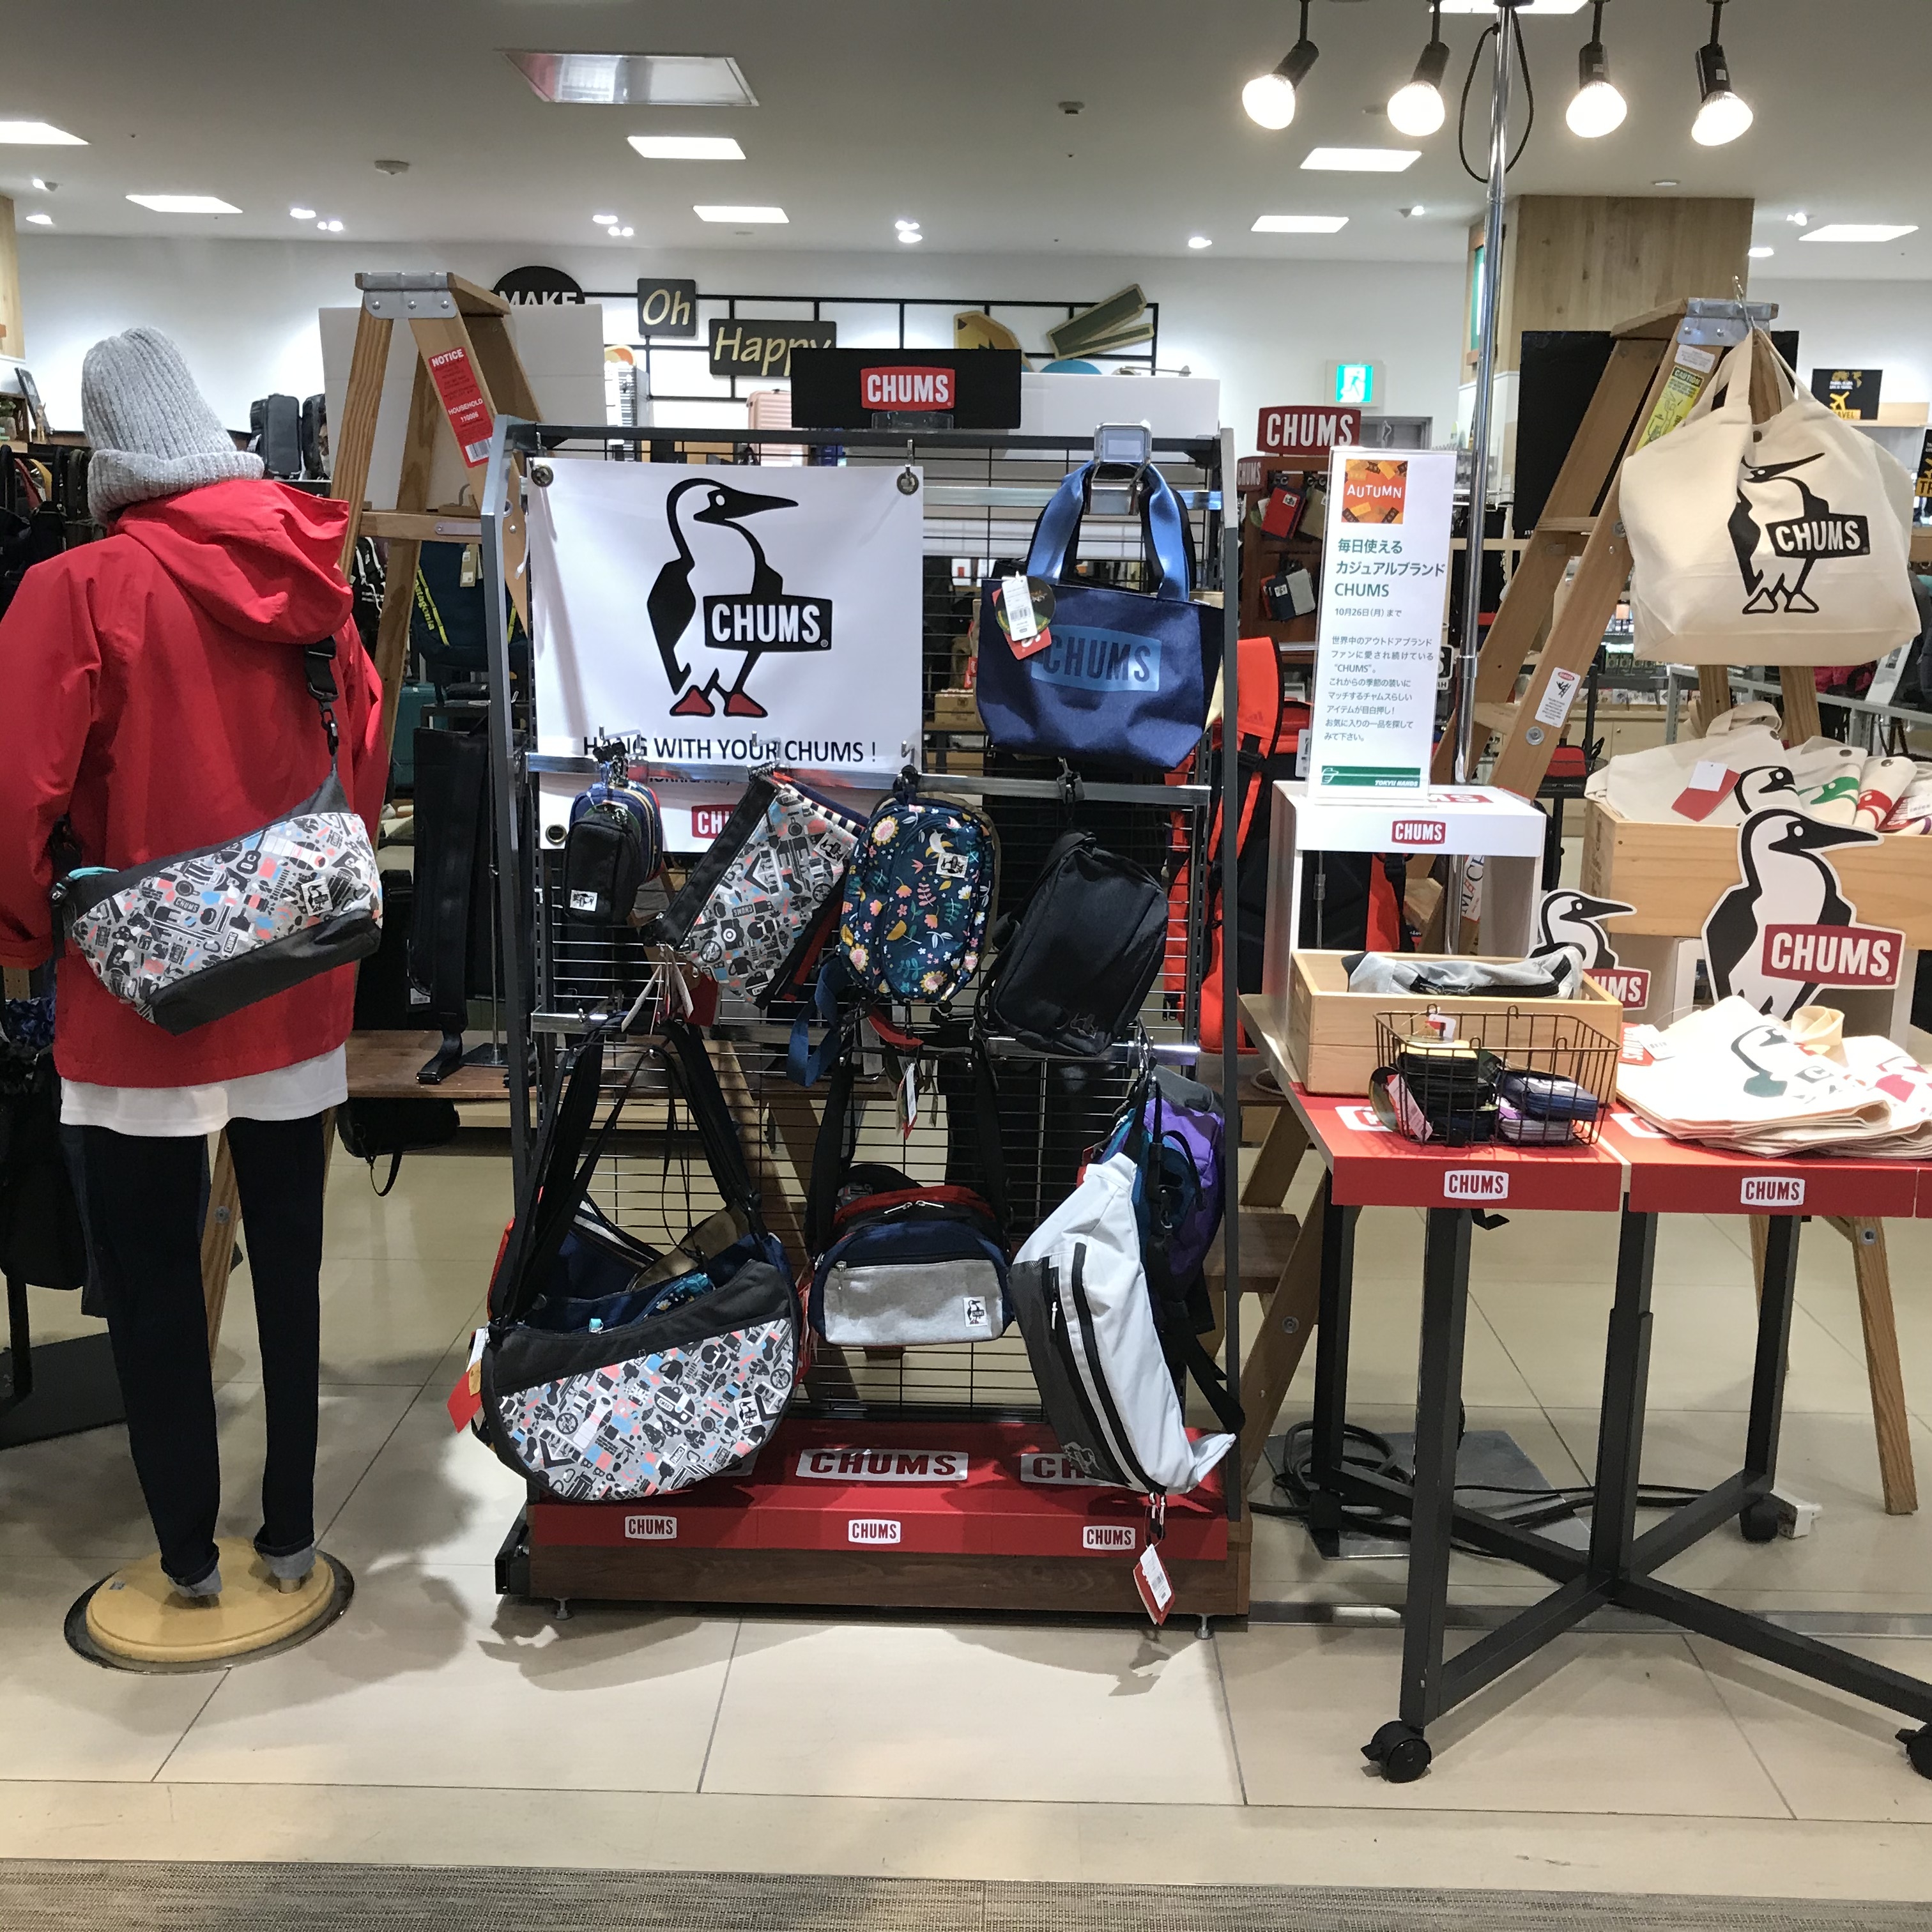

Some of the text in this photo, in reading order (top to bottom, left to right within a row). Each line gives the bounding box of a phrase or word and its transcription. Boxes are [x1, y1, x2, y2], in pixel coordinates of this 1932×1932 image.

[642, 289, 691, 326] Oh
[431, 349, 464, 367] NOTICE
[714, 327, 831, 376] Happ
[1675, 369, 1701, 385] CAUTION
[866, 374, 949, 402] CHUMS
[448, 398, 483, 415] HOUSEHOLD
[1266, 413, 1353, 447] CHUMS
[1347, 484, 1402, 498] AUTUMN
[1775, 519, 1862, 555] CHUMS
[1338, 539, 1403, 554] 毎日使える
[1336, 560, 1445, 577] カジュアルブランド
[1335, 583, 1390, 597] CHUMS
[712, 602, 821, 643] CHUMS
[1332, 636, 1432, 647] 世界中のアウトドアブランド
[1043, 634, 1150, 682] CHUMS
[1330, 678, 1411, 687] これからの季節の装いに
[1328, 692, 1413, 702] マッチするチャムスらしい
[1325, 718, 1414, 729] お気に入りの一品を探して
[654, 738, 711, 759] WITH
[717, 739, 777, 760] YOUR
[785, 740, 864, 762] CHUMS
[1395, 823, 1443, 841] CHUMS
[175, 899, 199, 912] CHUMS
[733, 905, 753, 917] CHUMS
[224, 931, 238, 953] CHUMS
[1771, 932, 1891, 977] CHUMS
[1448, 1174, 1504, 1195] CHUMS
[1745, 1181, 1800, 1201] CHUMS
[671, 1445, 685, 1464] CHUMS
[809, 1452, 957, 1477] CHUMS
[628, 1518, 675, 1536] CHUMS
[852, 1522, 898, 1540] CHUMS
[1086, 1529, 1132, 1545] CHUMS
